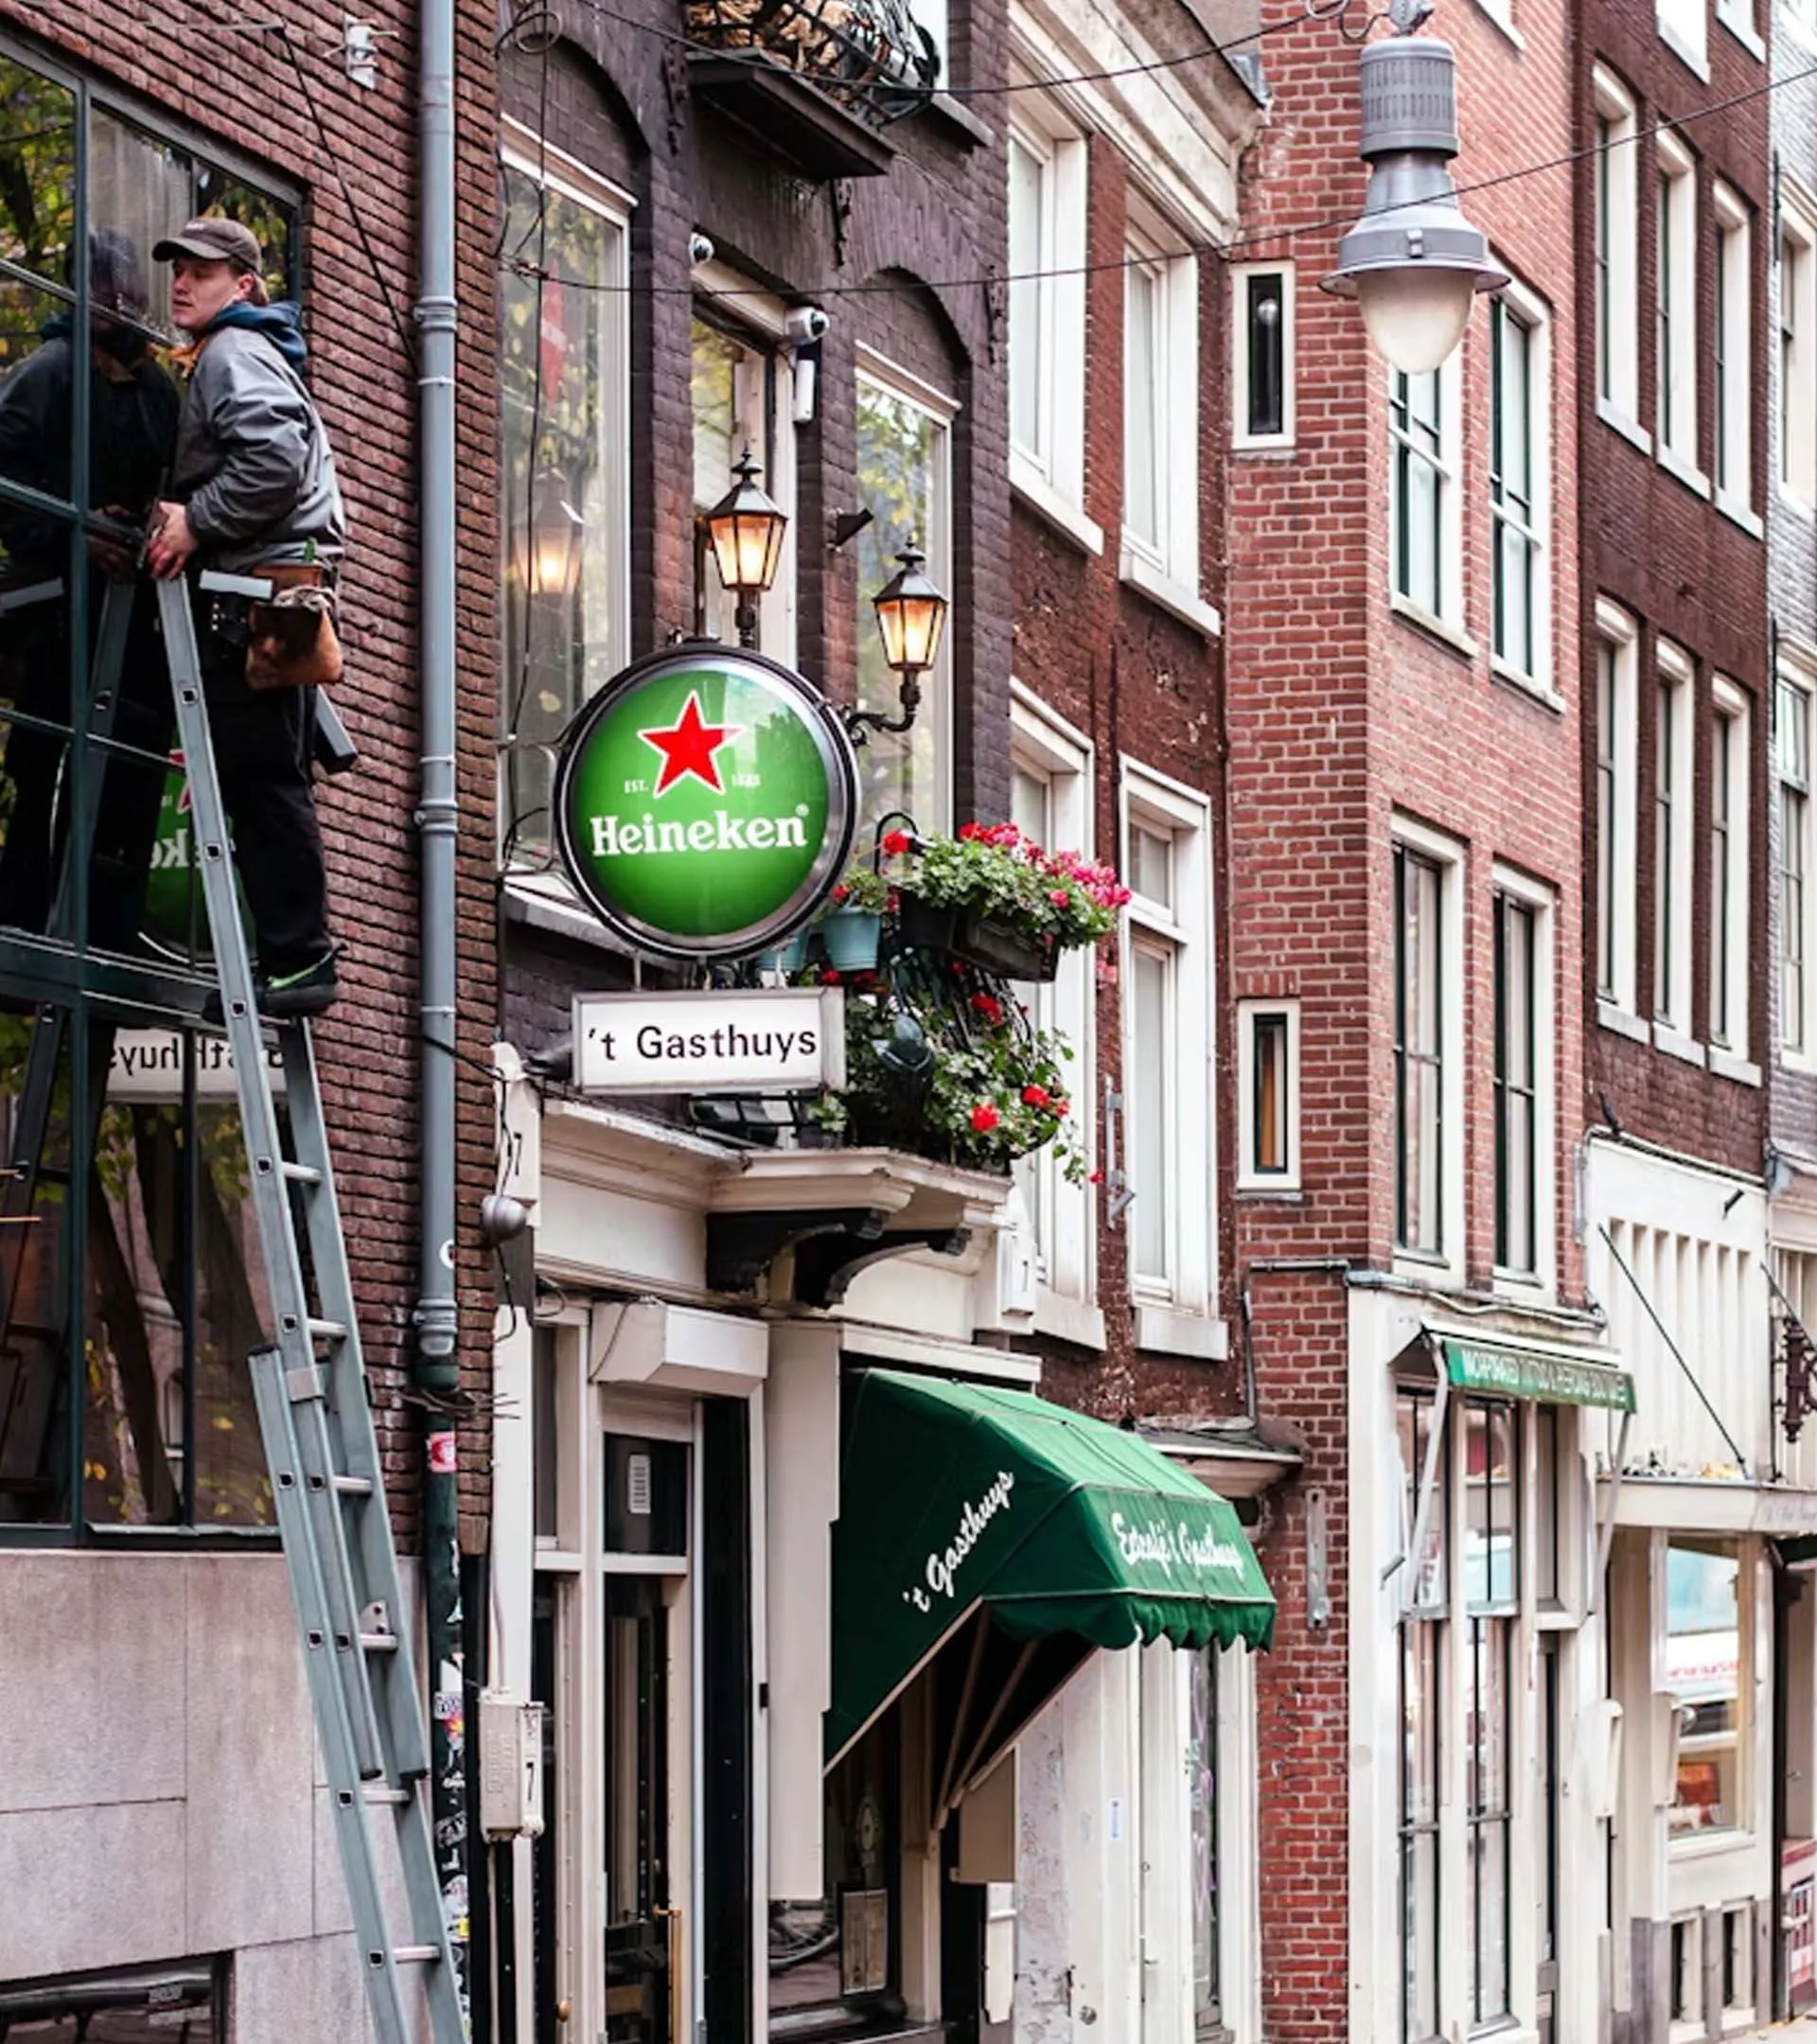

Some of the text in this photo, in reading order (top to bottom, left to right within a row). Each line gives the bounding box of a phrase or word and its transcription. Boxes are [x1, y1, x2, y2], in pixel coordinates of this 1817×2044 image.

[591, 809, 808, 856] Heineken
[636, 1024, 817, 1063] Gasthuys
[926, 1470, 1014, 1597] Gasthuys
